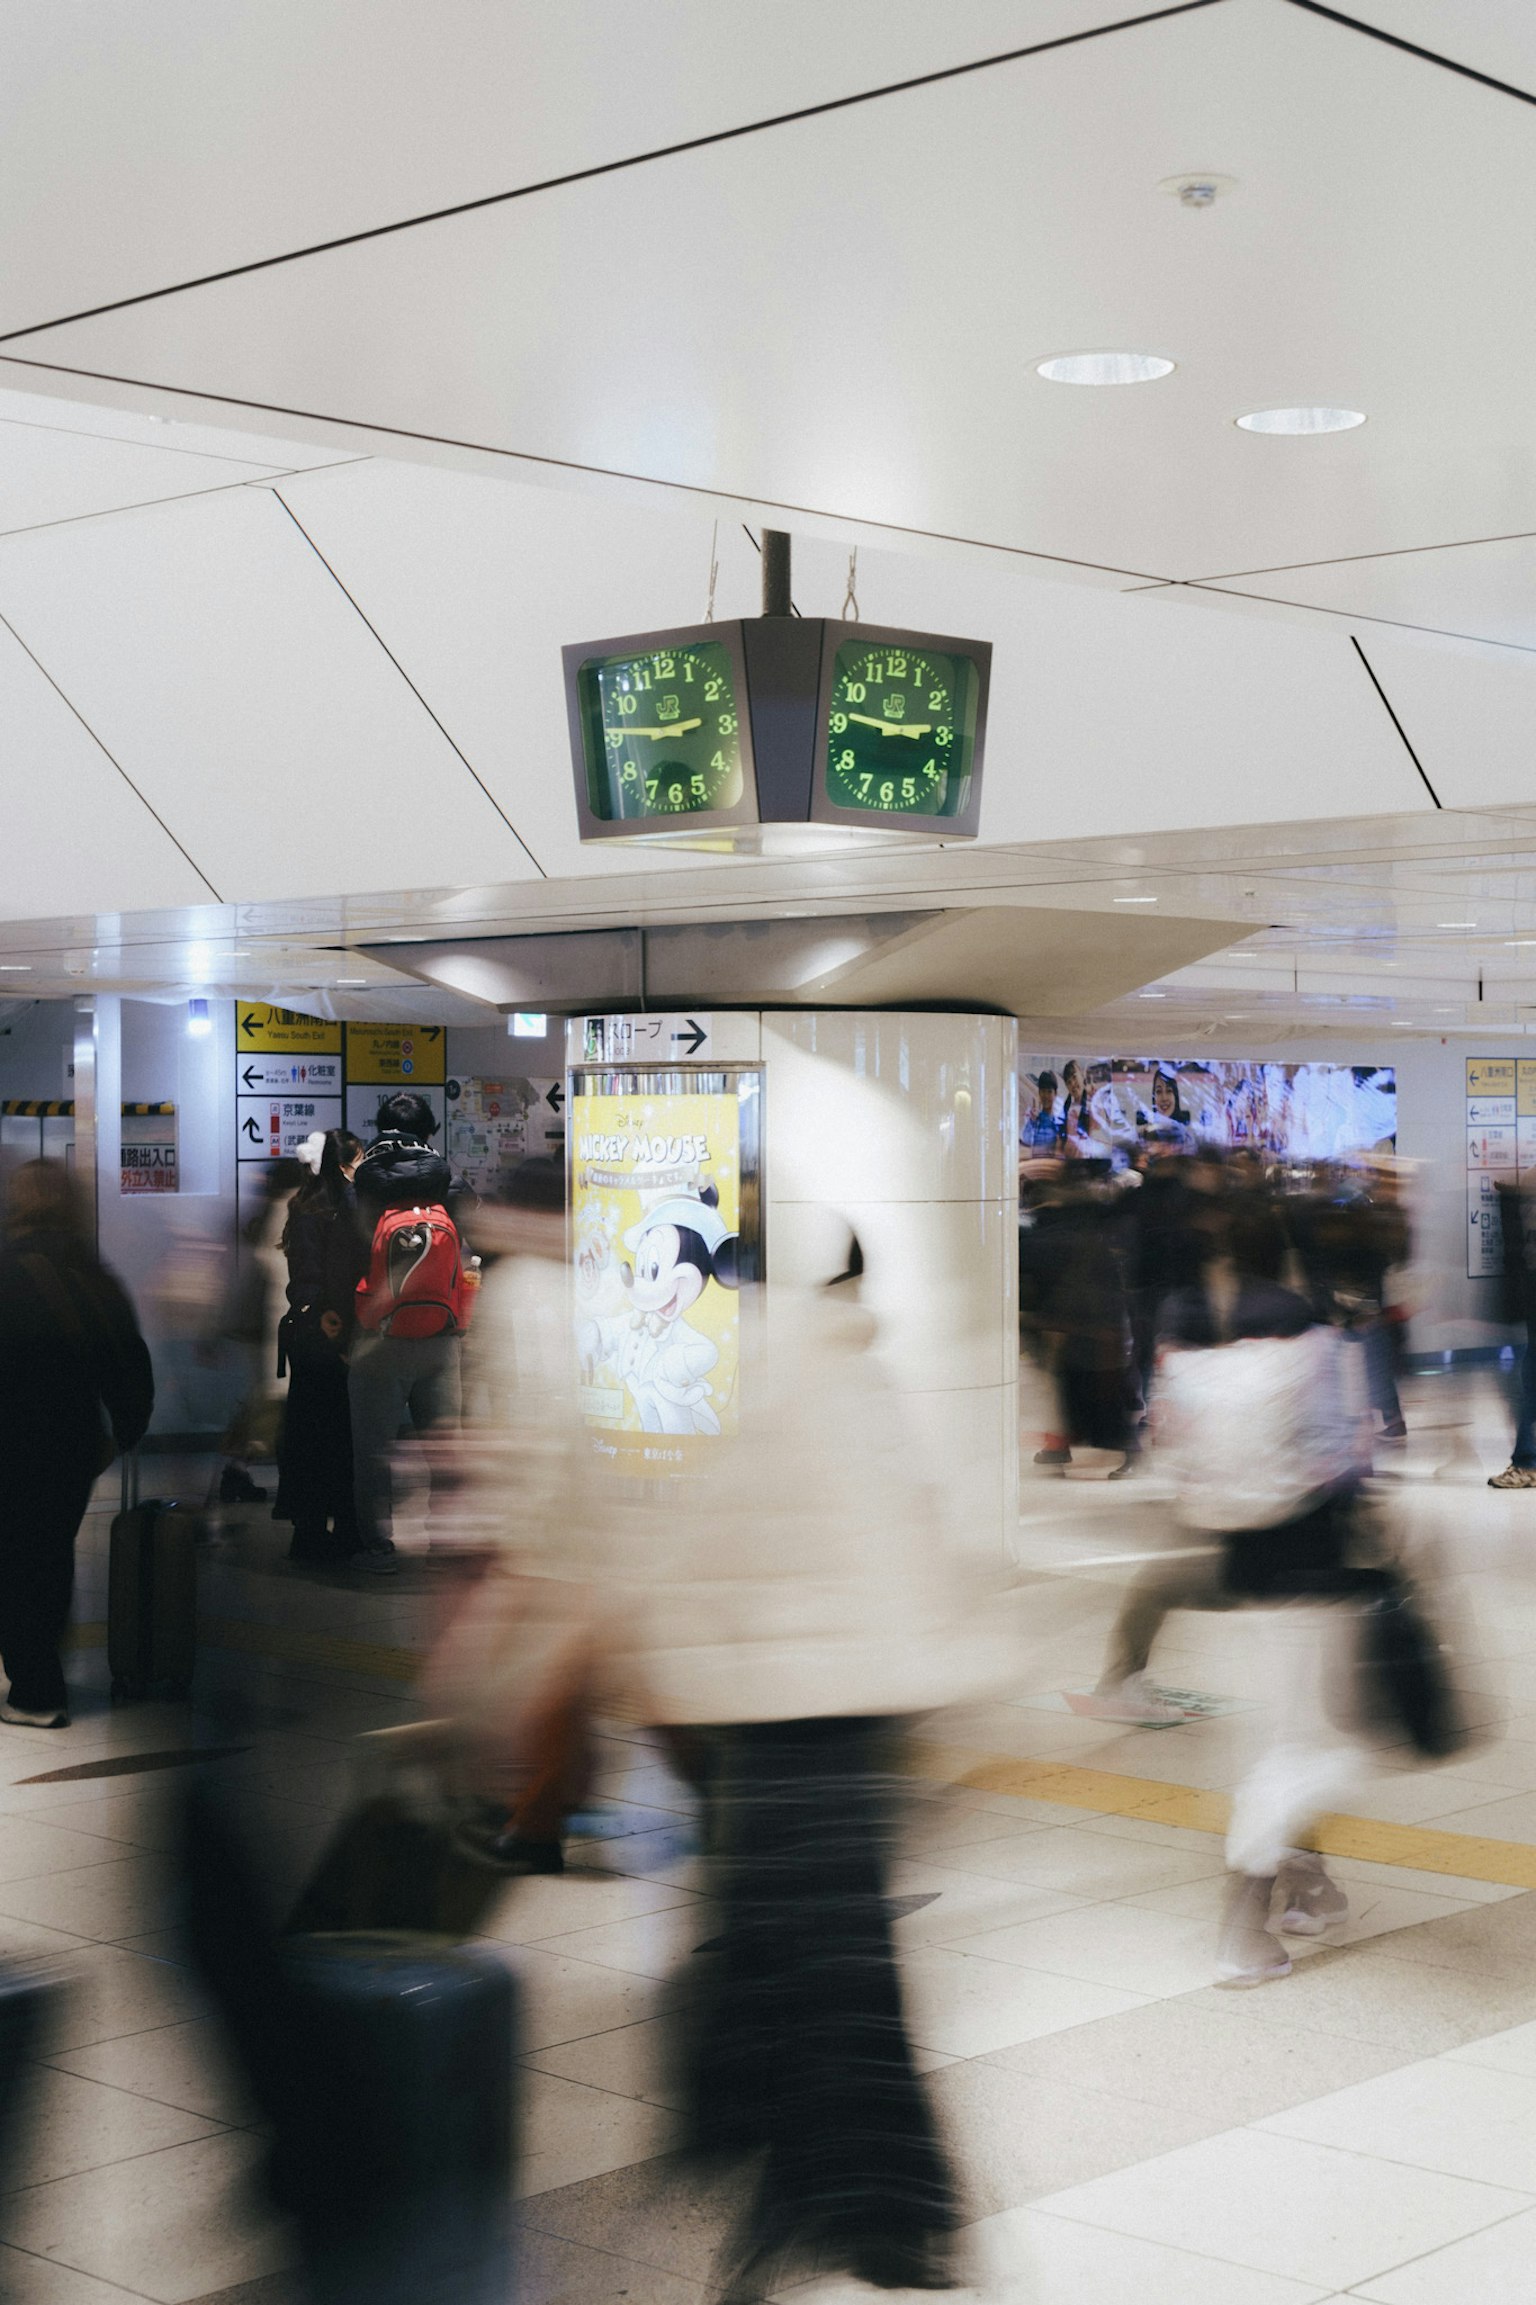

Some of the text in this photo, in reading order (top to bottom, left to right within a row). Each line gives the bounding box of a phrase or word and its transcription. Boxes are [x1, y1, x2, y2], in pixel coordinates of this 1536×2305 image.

[654, 659, 676, 679] 12
[684, 663, 694, 682] 1
[865, 662, 883, 683] 11
[886, 656, 907, 678] 12
[914, 667, 922, 687] 1
[633, 671, 652, 691] 11
[704, 681, 719, 702] 2
[845, 682, 866, 703] 10
[928, 690, 942, 711] 2
[617, 694, 637, 715] 10
[656, 695, 680, 715] JR
[883, 693, 905, 713] JR
[718, 714, 733, 735] 3
[833, 713, 847, 734] 9
[935, 726, 949, 746] 3
[710, 751, 725, 771] 4
[840, 749, 855, 770] 8
[923, 758, 937, 778] 4
[623, 761, 637, 781] 8
[645, 780, 659, 800] 7
[668, 783, 683, 804] 6
[691, 774, 706, 796] 5
[859, 773, 874, 794] 7
[880, 782, 894, 802] 6
[901, 778, 916, 798] 5
[291, 1031, 311, 1040] South
[312, 1031, 326, 1039] Exit
[608, 1020, 664, 1039] スロープ
[308, 1065, 336, 1077] 化粧室
[283, 1103, 315, 1117] 京葉線
[580, 1133, 712, 1164] MICKEY MOUSE
